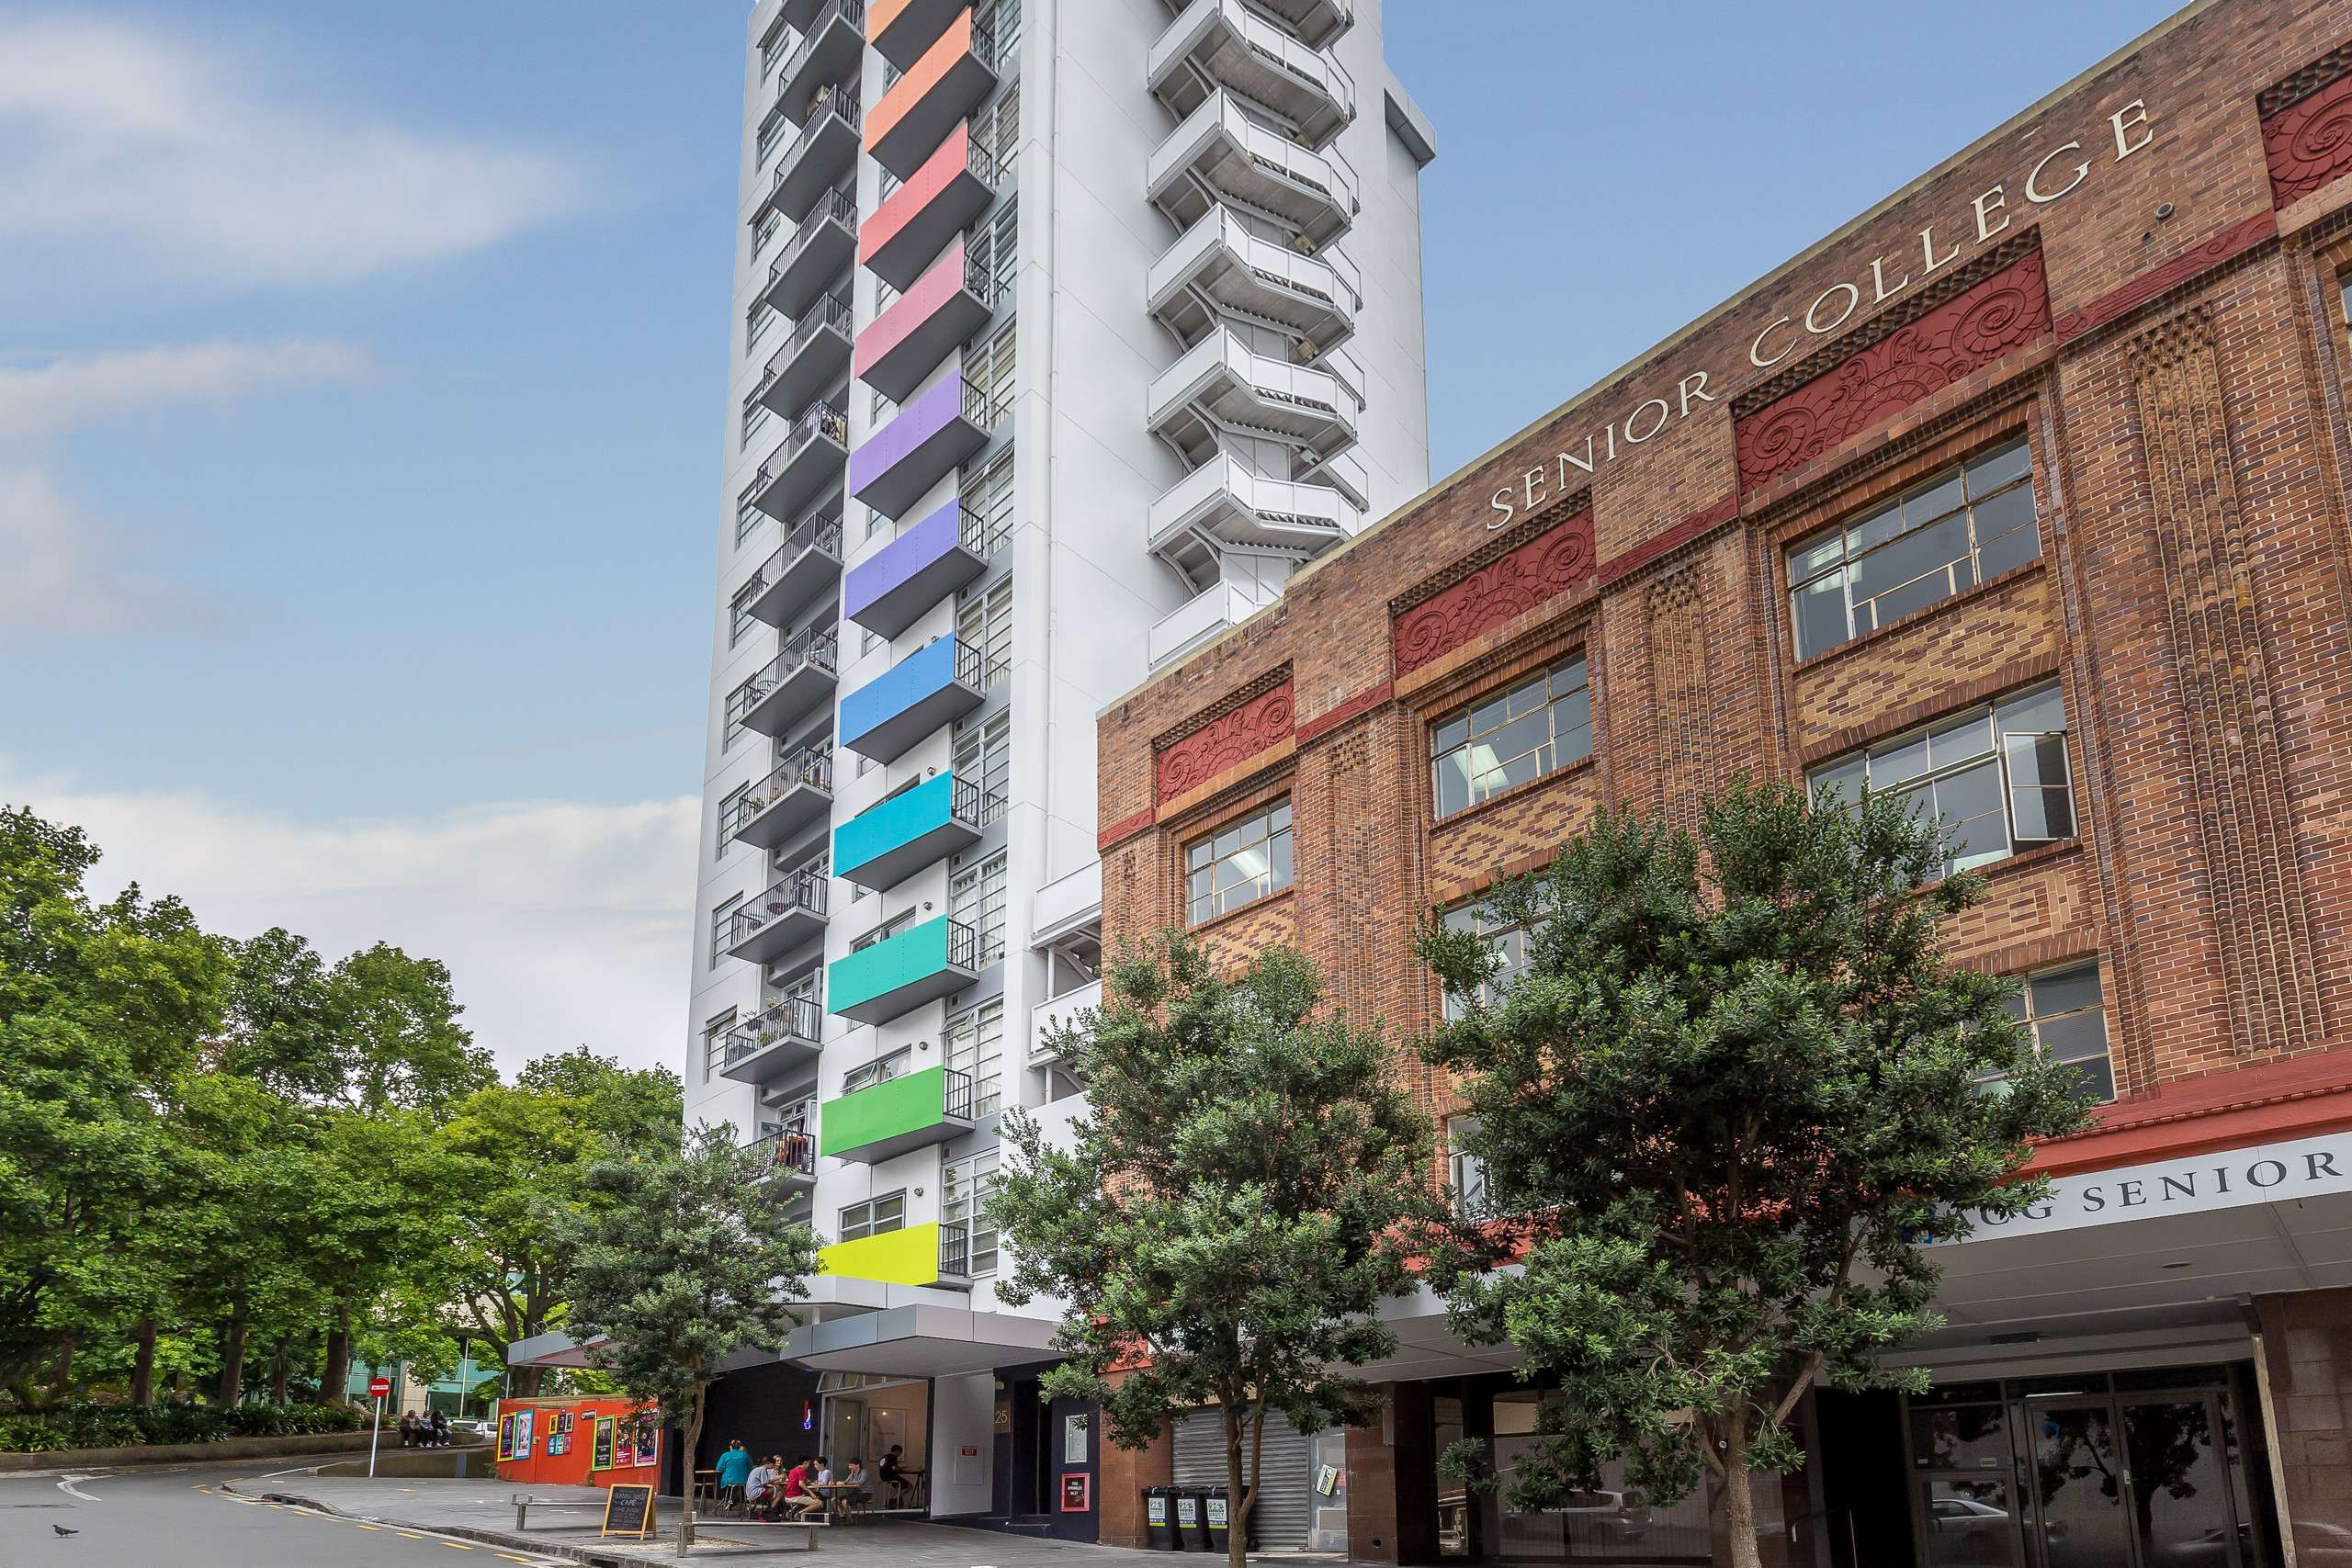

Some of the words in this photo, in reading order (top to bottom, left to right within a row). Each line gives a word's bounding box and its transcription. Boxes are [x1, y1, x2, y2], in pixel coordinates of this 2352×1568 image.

[1486, 370, 1716, 531] SENIOR
[1748, 97, 2154, 367] COLLEGE
[2082, 1151, 2344, 1213] SENIOR
